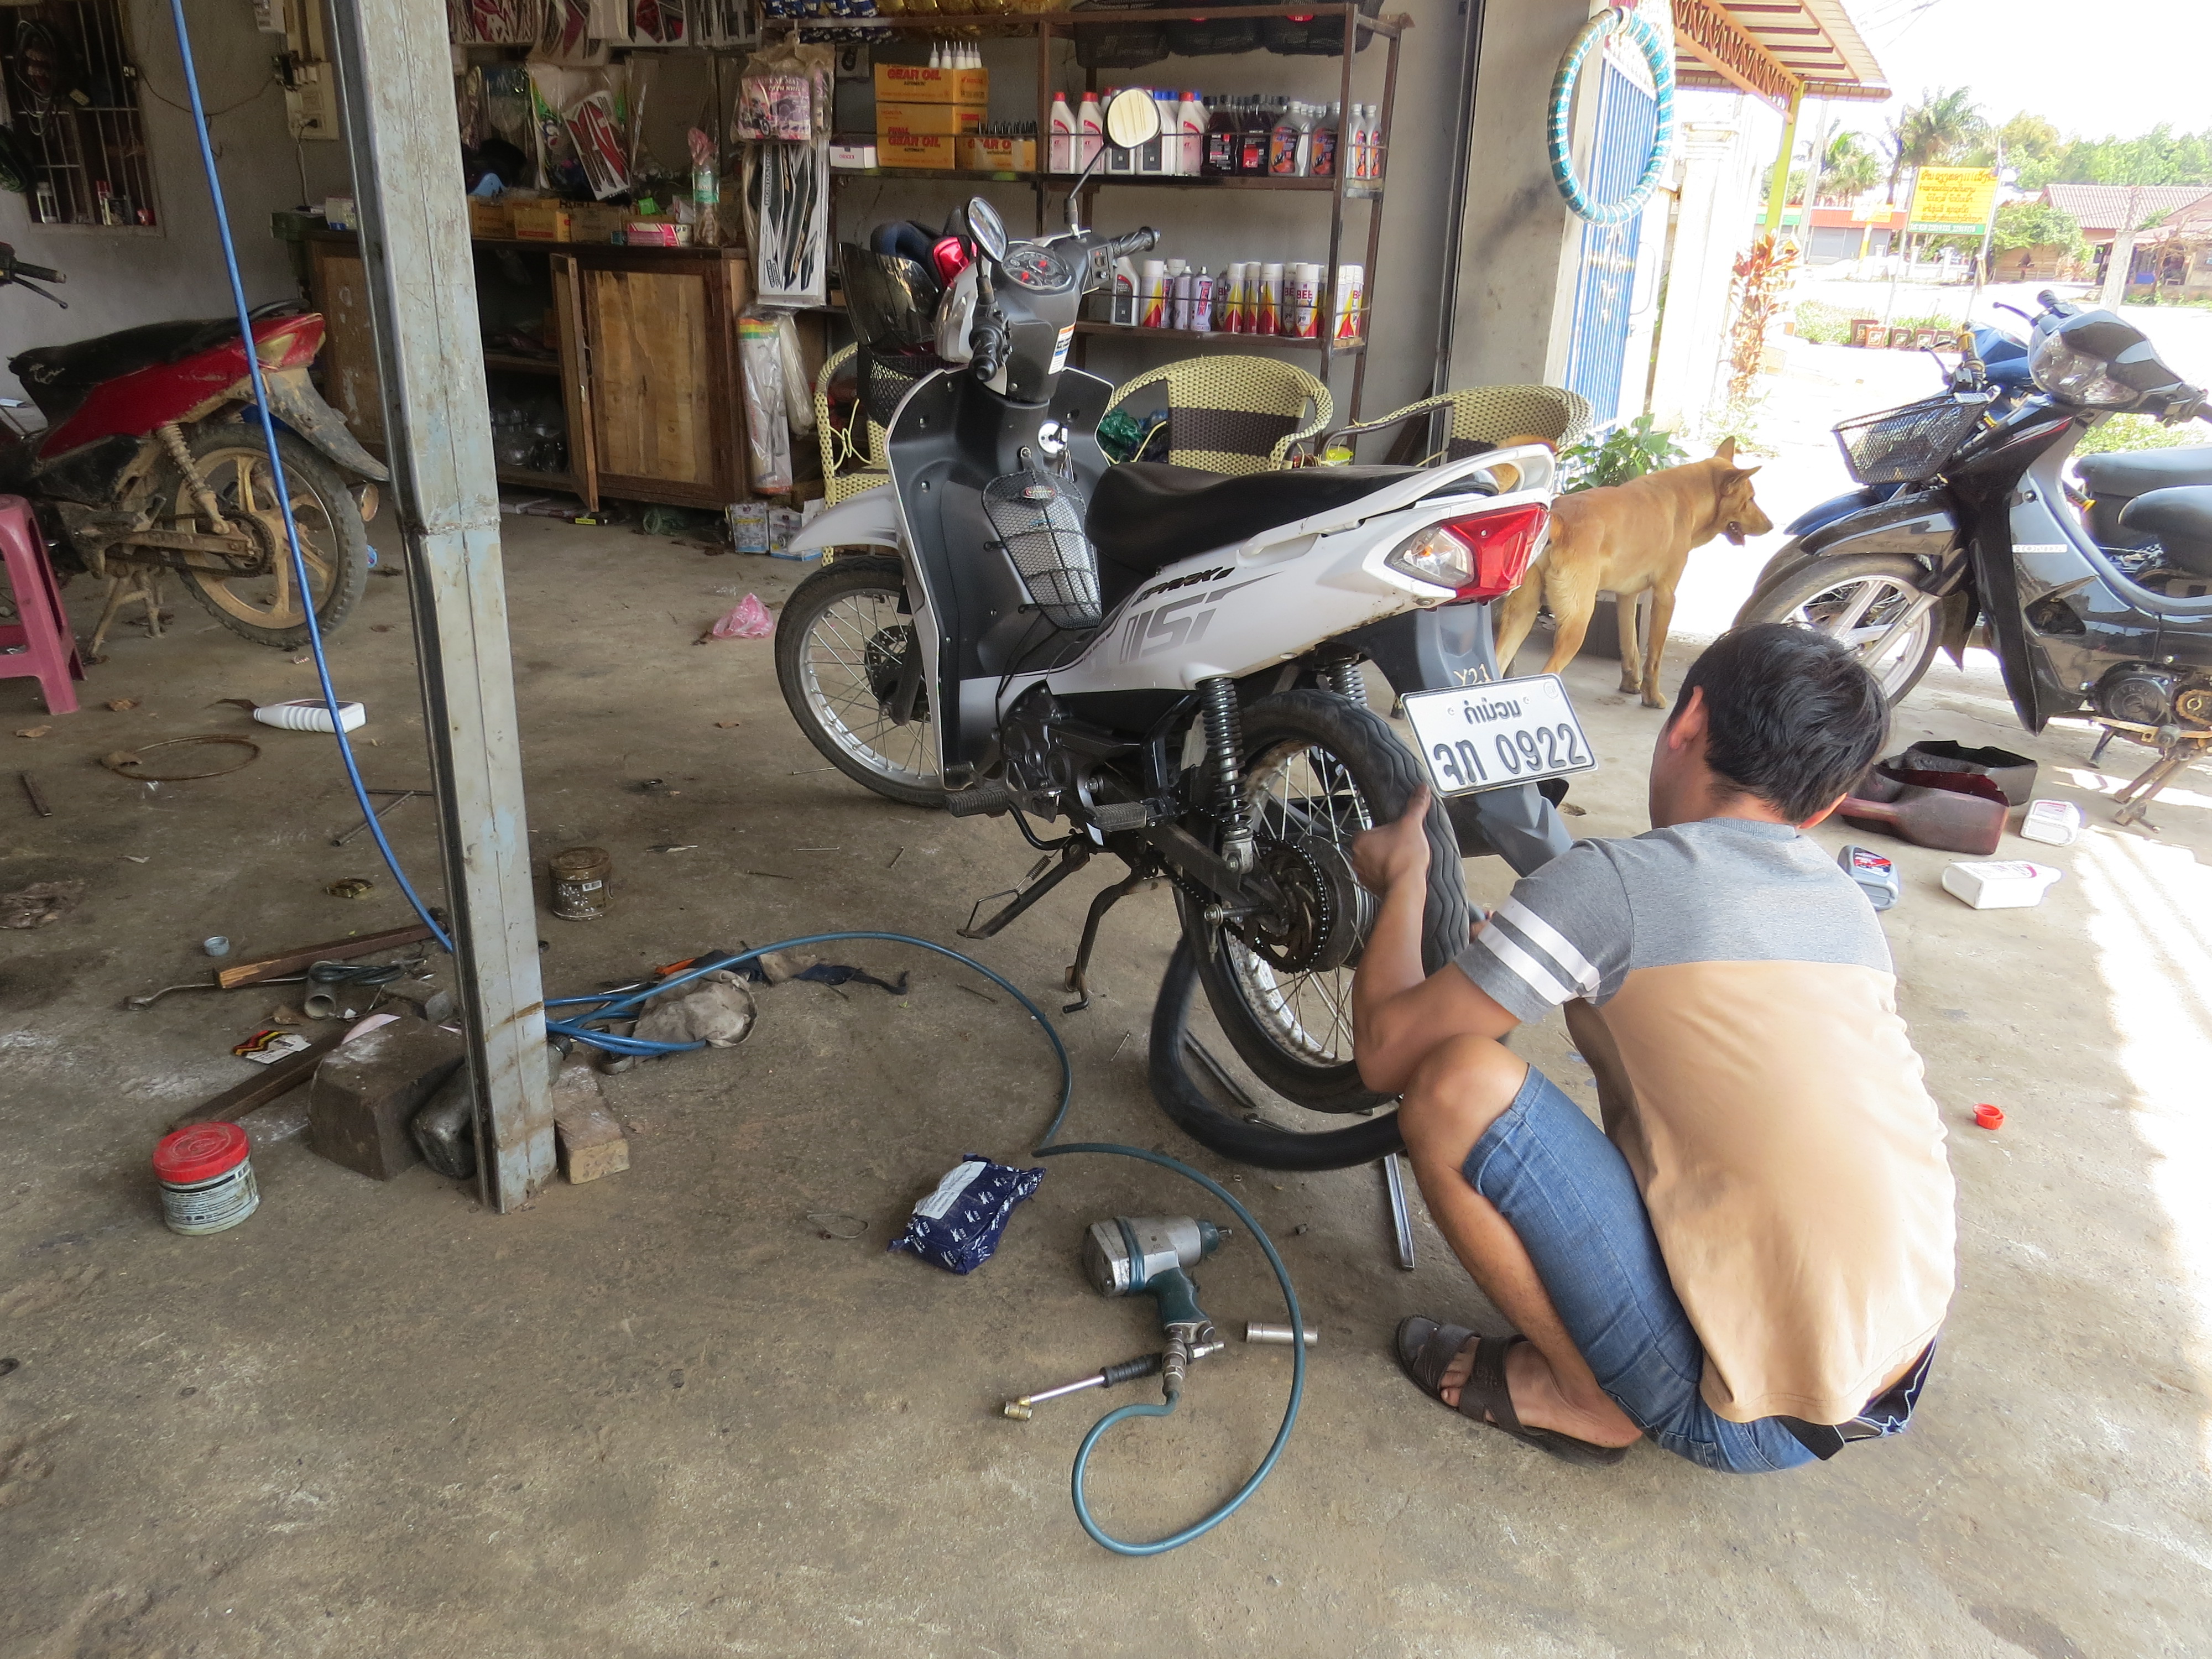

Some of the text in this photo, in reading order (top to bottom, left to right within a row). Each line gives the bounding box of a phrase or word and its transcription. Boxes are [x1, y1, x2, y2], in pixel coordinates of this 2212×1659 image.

[887, 67, 941, 81] GEAR OIL
[888, 136, 941, 148] GEAR OIL
[1297, 290, 1312, 299] BEE
[1495, 723, 1586, 775] 0922
